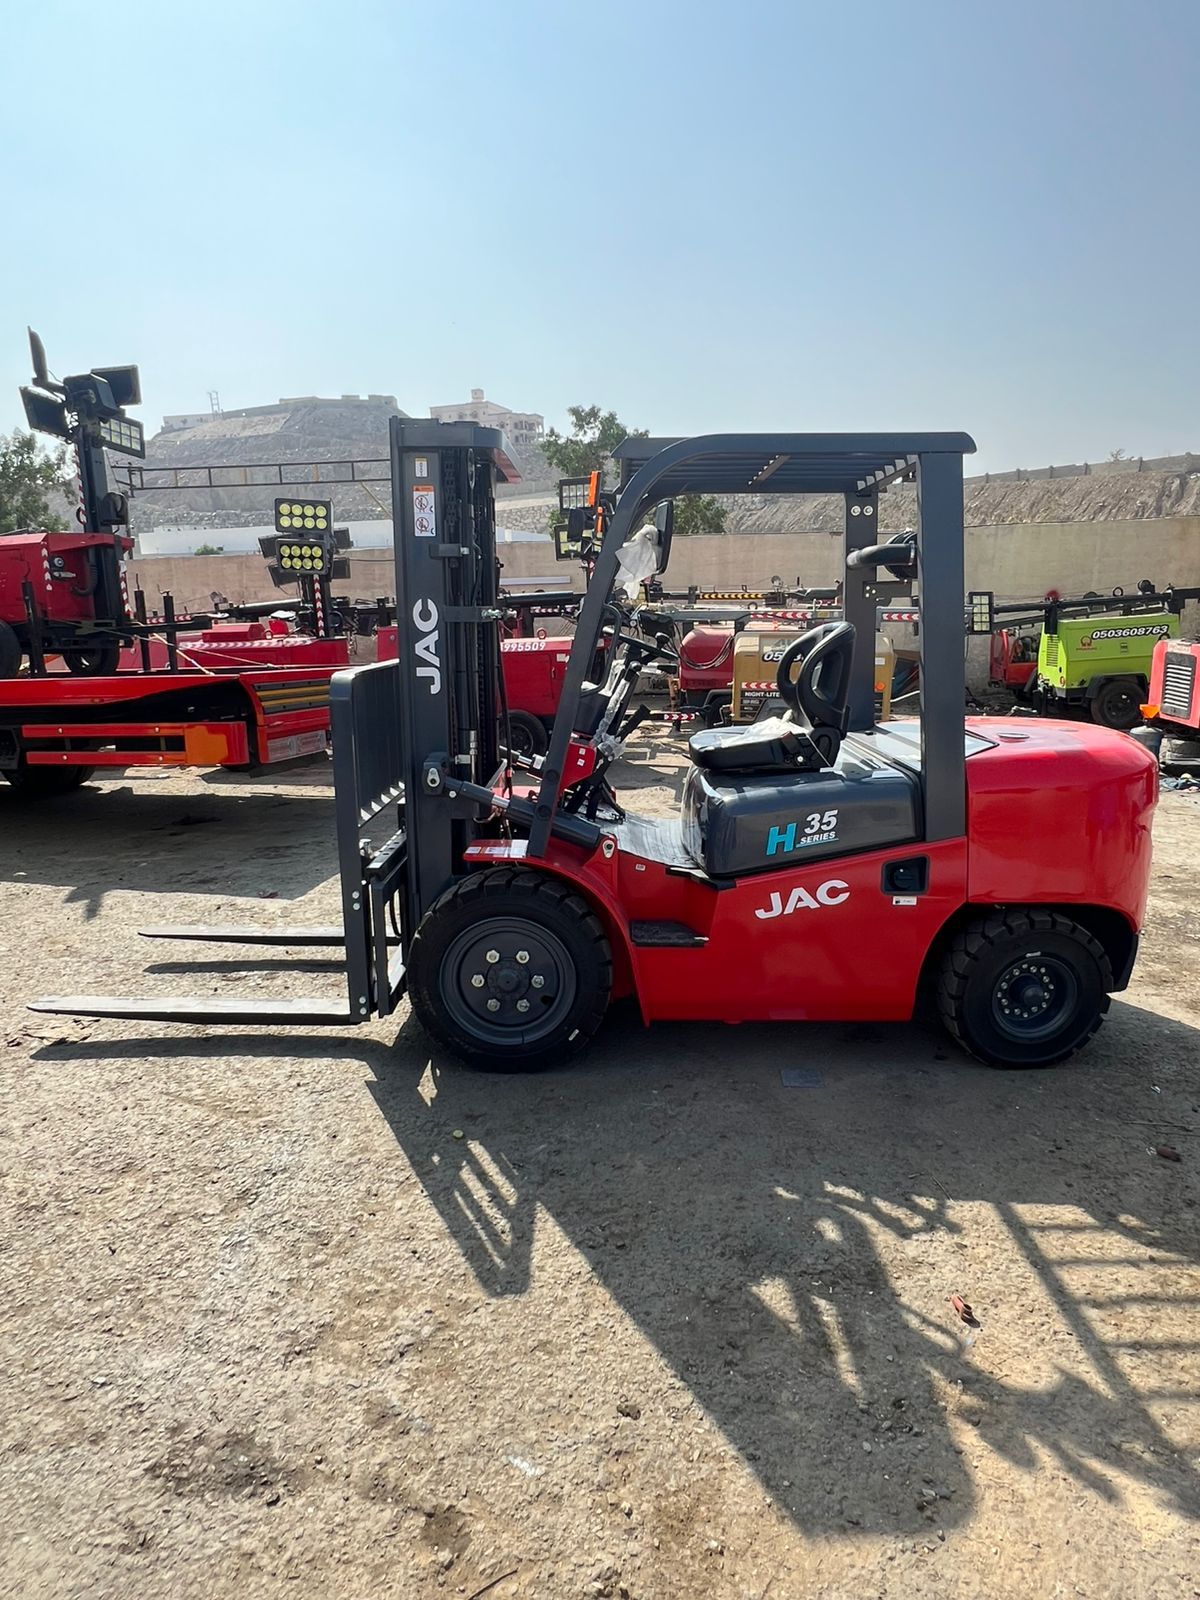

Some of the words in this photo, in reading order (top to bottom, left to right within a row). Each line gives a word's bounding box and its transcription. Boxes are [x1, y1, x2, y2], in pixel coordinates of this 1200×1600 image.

[412, 598, 441, 695] JAC
[1092, 625, 1168, 639] 0503608763
[766, 822, 797, 856] H
[804, 809, 839, 834] 35
[800, 831, 836, 845] SERIES
[754, 879, 851, 919] JAC
